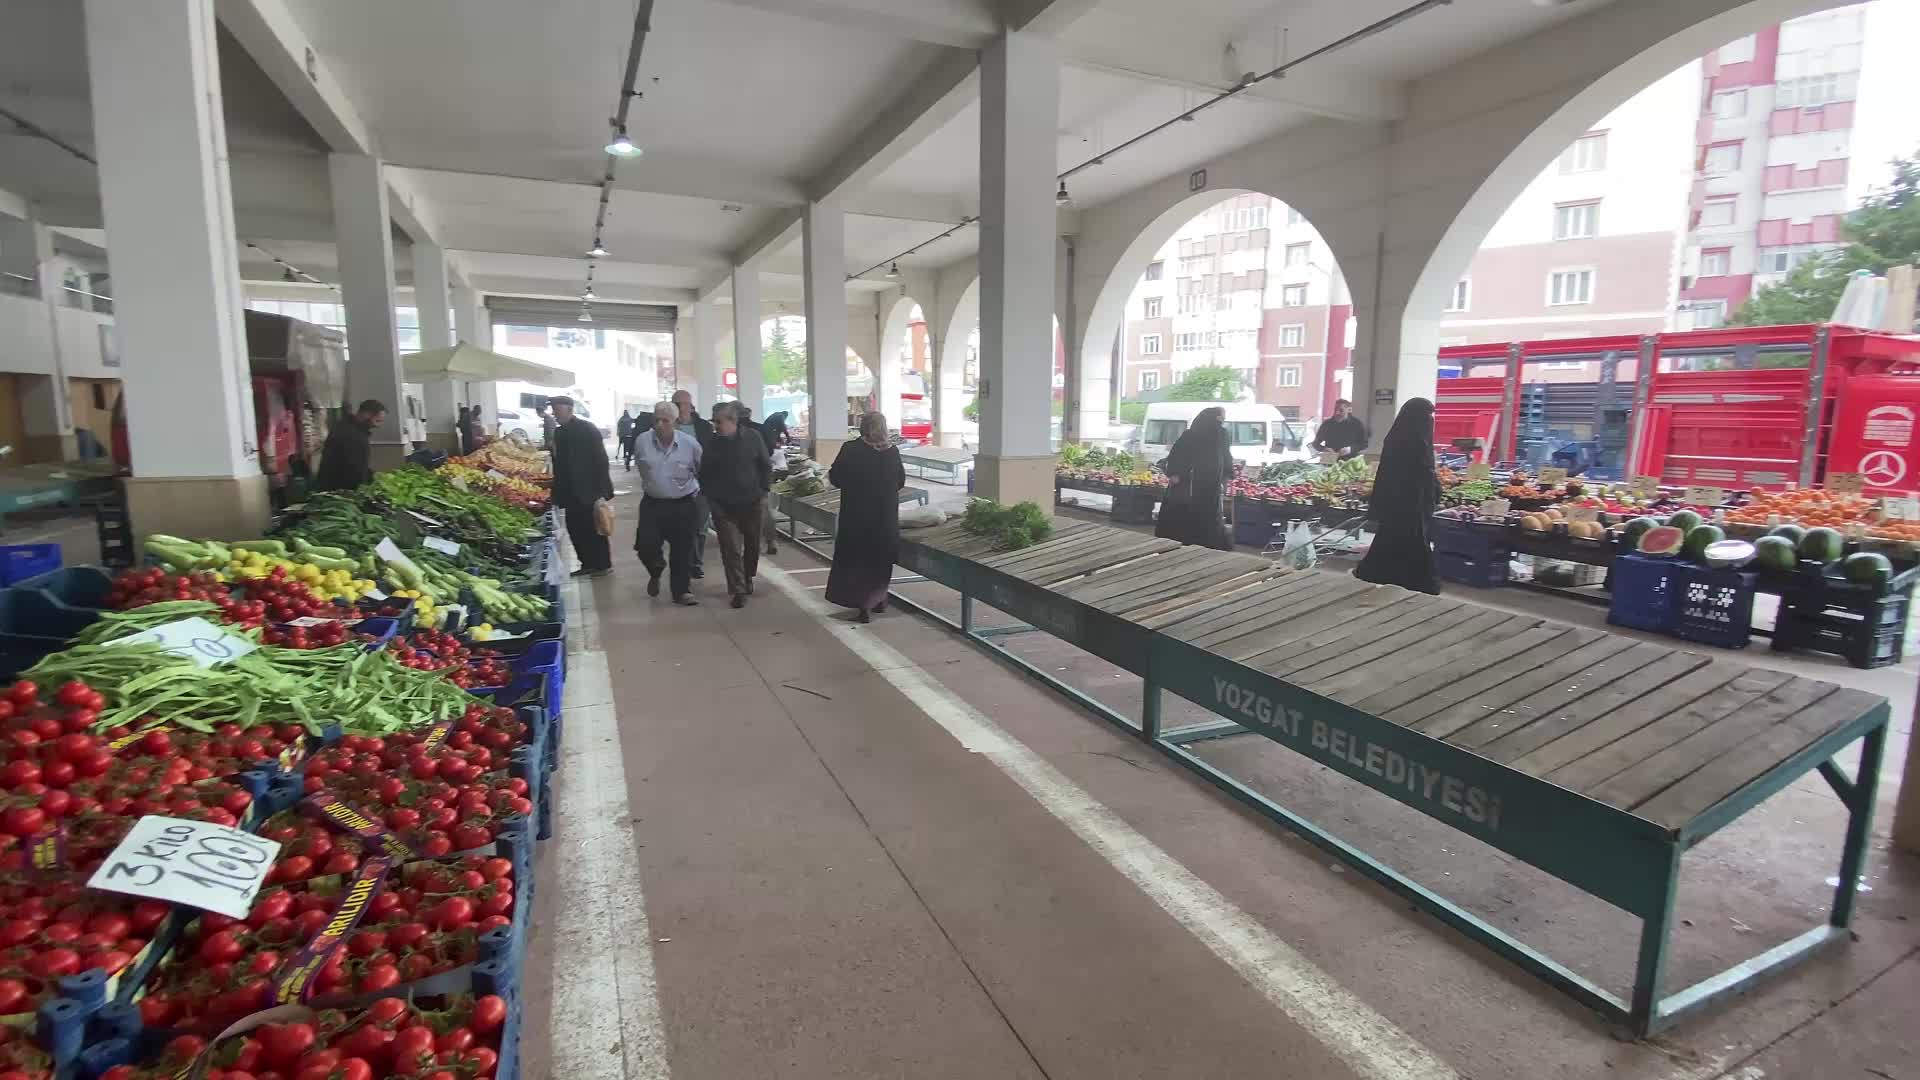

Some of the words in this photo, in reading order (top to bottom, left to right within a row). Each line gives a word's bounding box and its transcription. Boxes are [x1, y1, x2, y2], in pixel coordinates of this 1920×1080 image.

[1212, 676, 1304, 737] YOZGAT
[107, 861, 165, 886] 3
[322, 877, 378, 936] ARILIDIR
